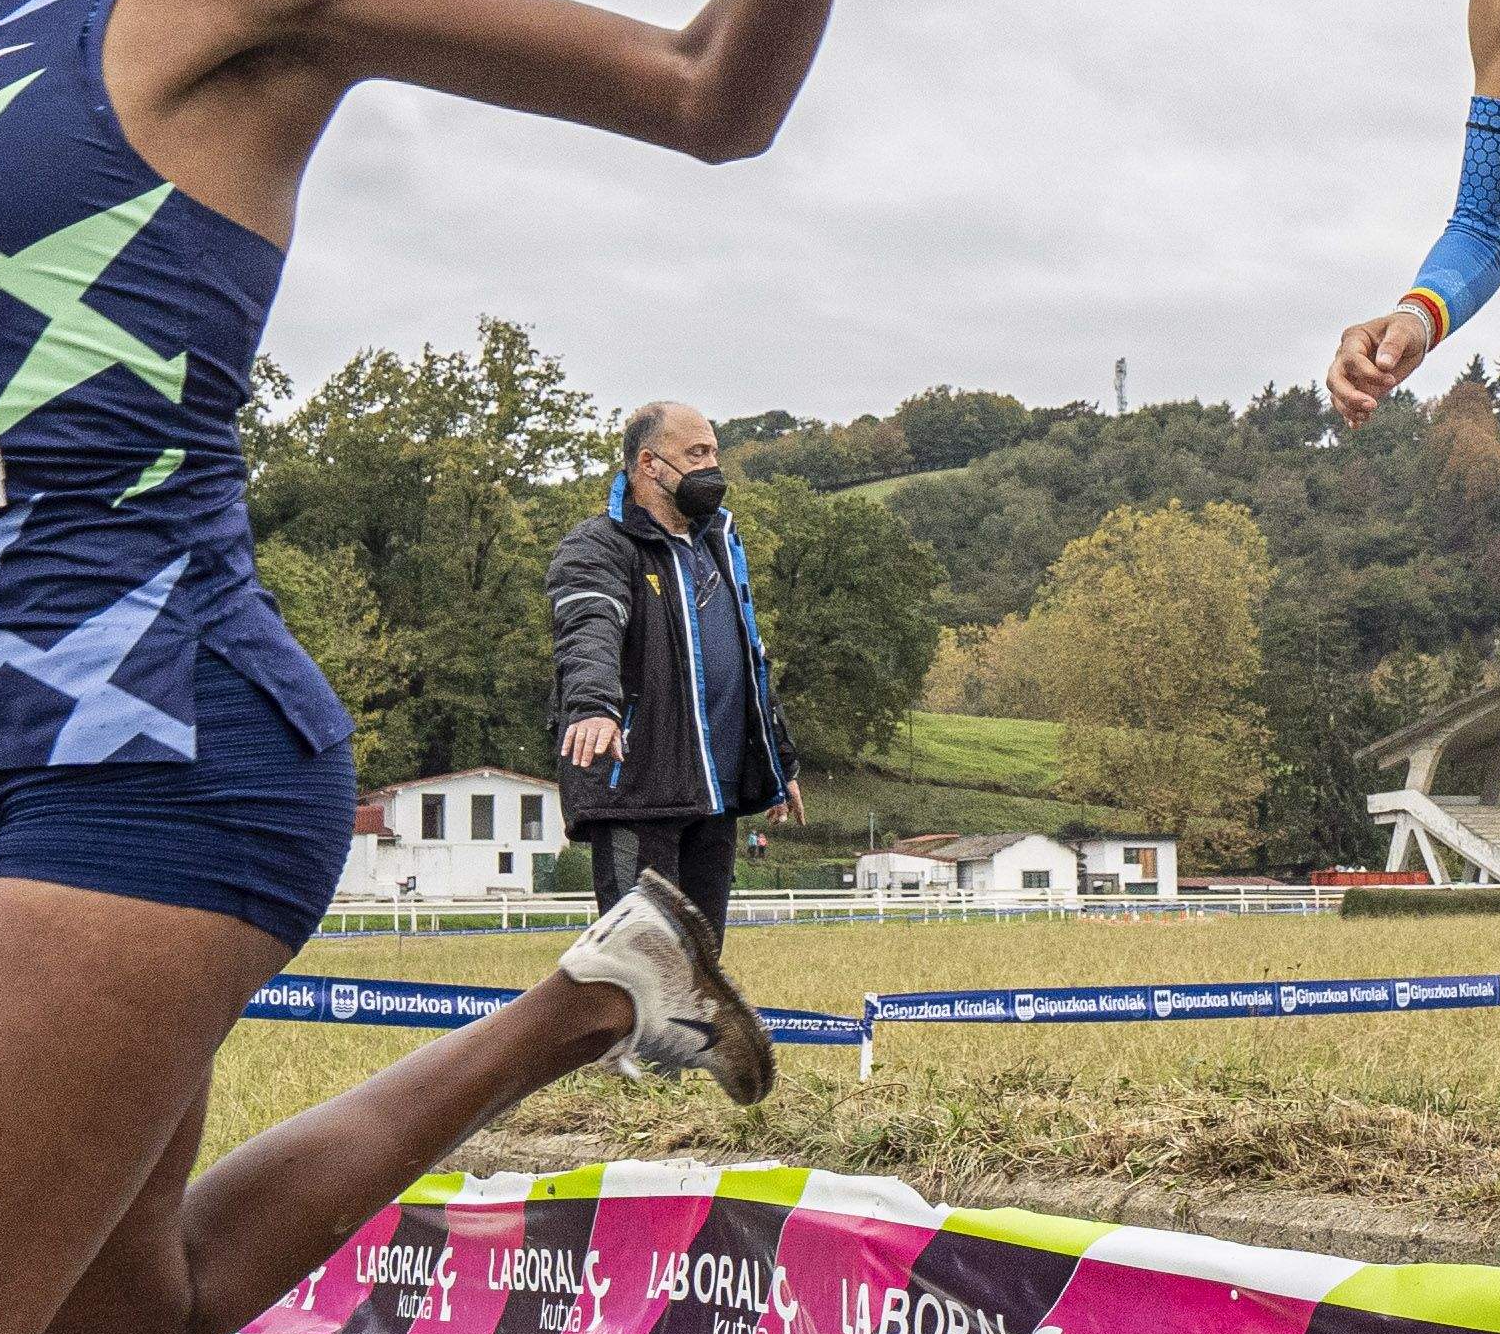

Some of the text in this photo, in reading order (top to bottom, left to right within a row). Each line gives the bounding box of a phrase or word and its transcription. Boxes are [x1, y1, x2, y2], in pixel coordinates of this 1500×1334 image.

[360, 990, 510, 1016] Gipuzkoa Kirol
[1034, 994, 1147, 1016] Gipuzkoa Kirolak
[1171, 990, 1273, 1011] Gipuzkoa Kirolak
[1296, 986, 1389, 1007] Gipuzkoa Kirolak
[1410, 982, 1495, 1002] Gipuzkoa Kirolak
[954, 998, 1006, 1017] Kirolak
[356, 1245, 434, 1287] LABORAL
[488, 1247, 585, 1294] LABORAL
[647, 1250, 771, 1314] LABORAL
[396, 1289, 433, 1320] kutxa
[539, 1296, 583, 1334] kutxa
